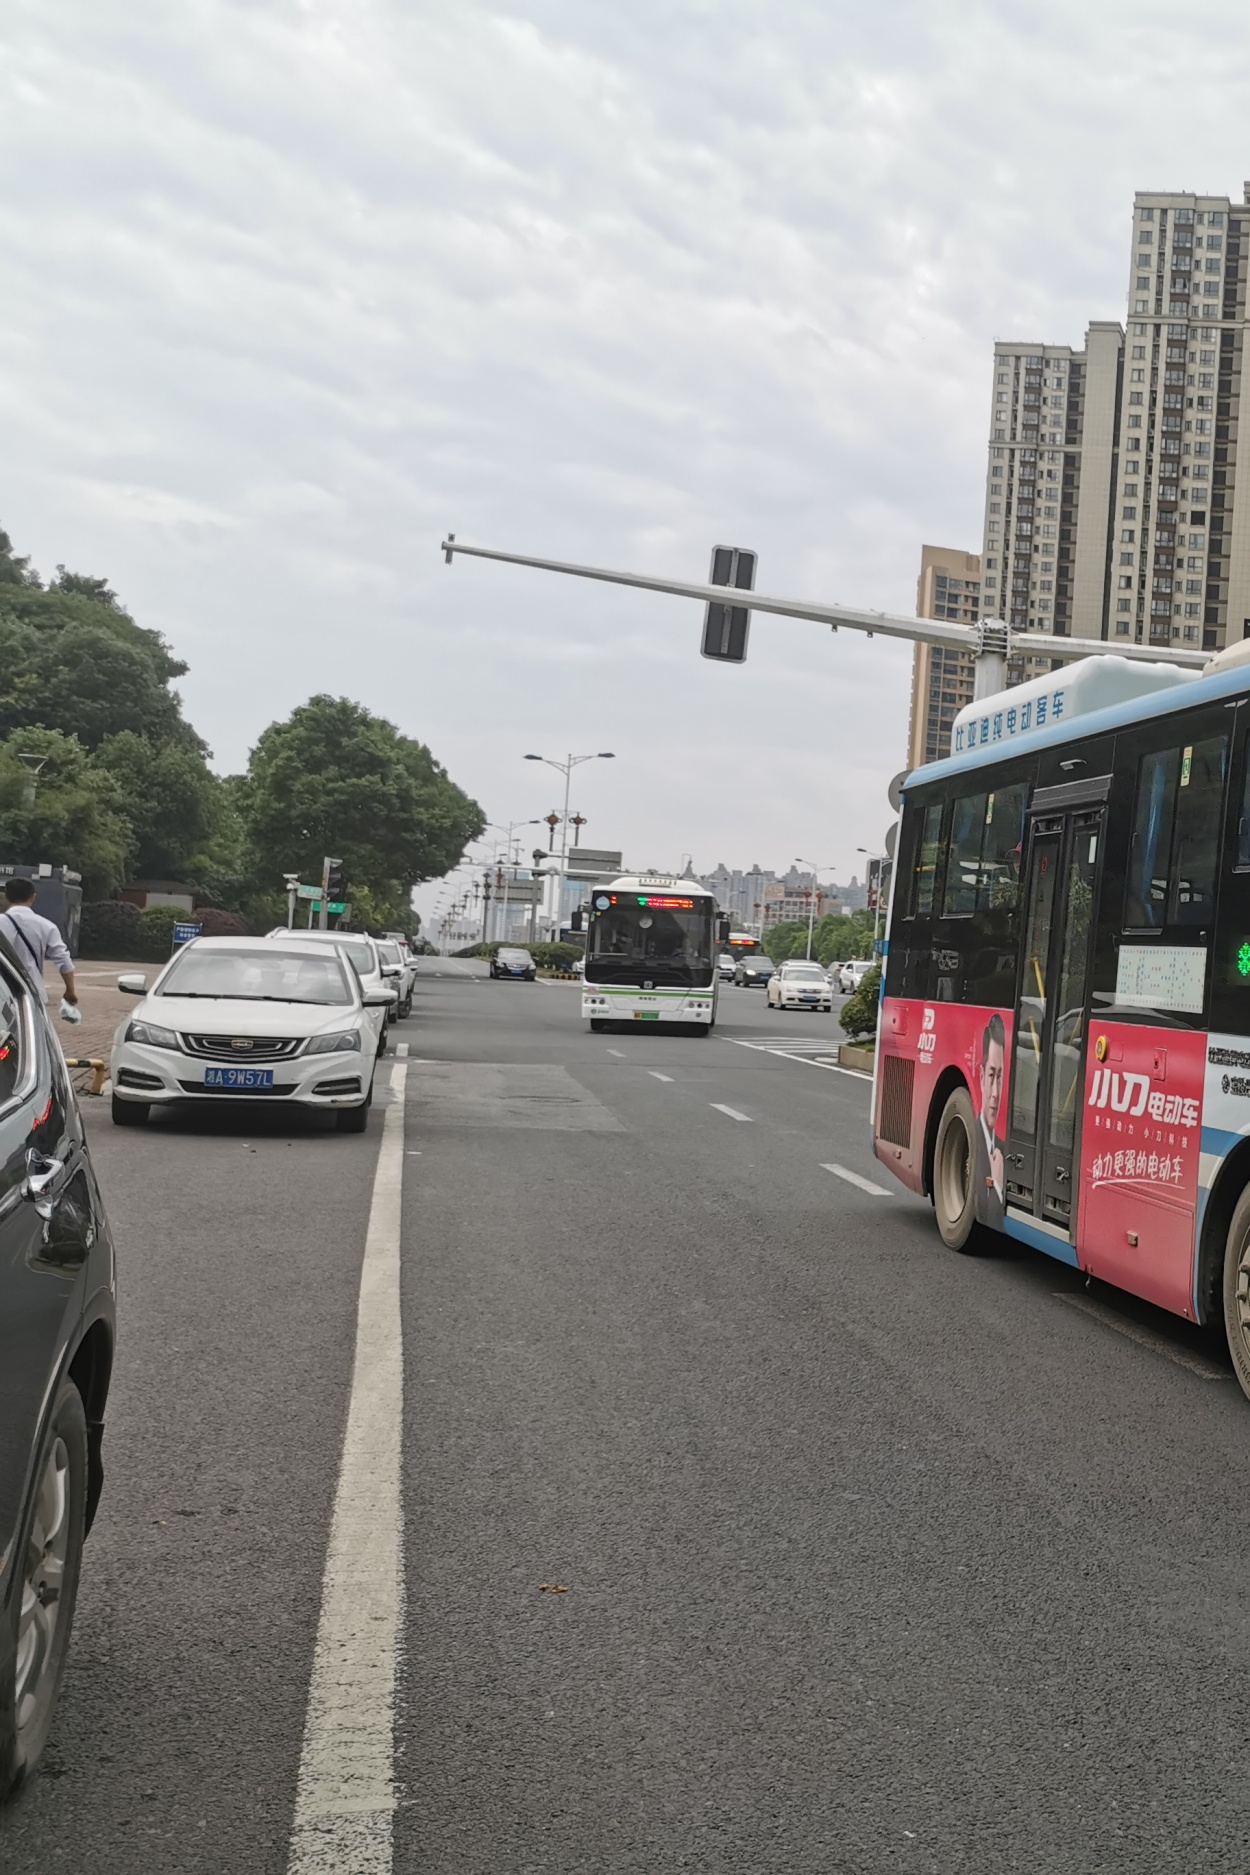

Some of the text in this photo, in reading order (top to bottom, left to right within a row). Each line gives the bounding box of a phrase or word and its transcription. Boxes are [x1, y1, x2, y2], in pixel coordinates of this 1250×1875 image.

[955, 691, 1064, 752] 比亚迪纯电动客车
[1092, 1149, 1185, 1184] 动力更强的电动车
